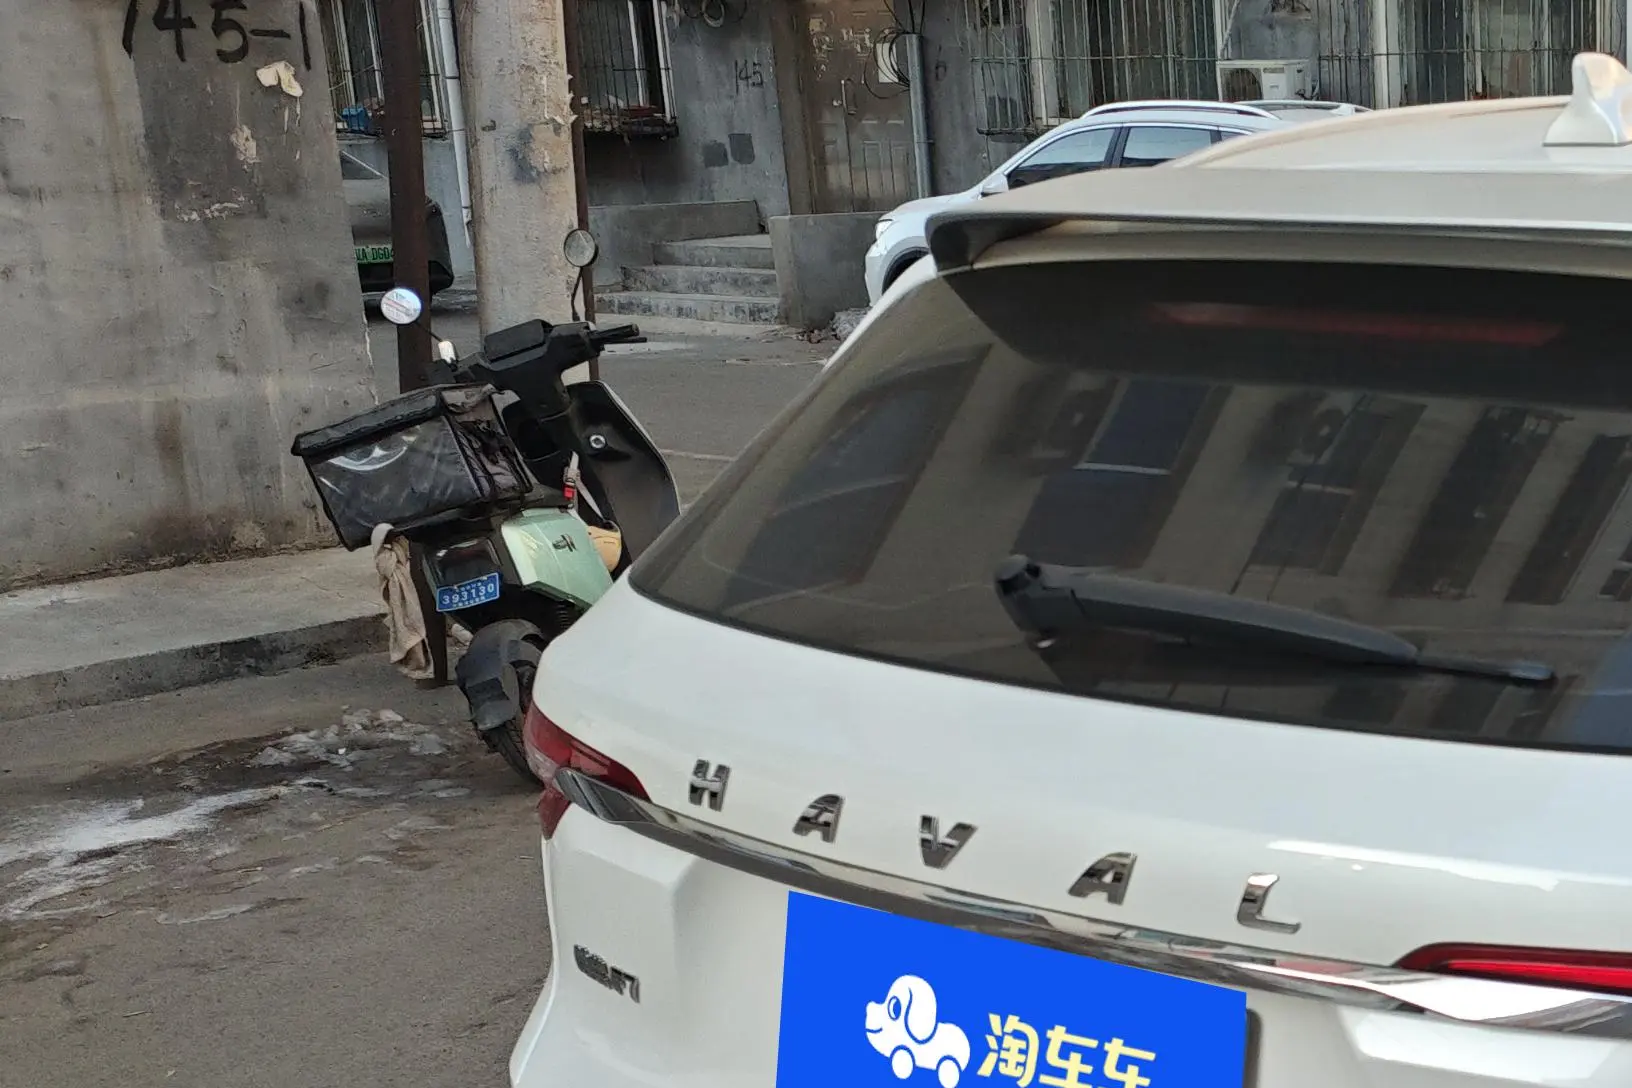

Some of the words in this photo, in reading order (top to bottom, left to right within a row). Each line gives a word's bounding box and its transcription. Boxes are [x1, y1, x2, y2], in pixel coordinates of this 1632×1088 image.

[121, 0, 312, 71] 145-1
[734, 59, 764, 95] 145
[441, 583, 495, 605] 393130
[688, 760, 1301, 935] HAVAL
